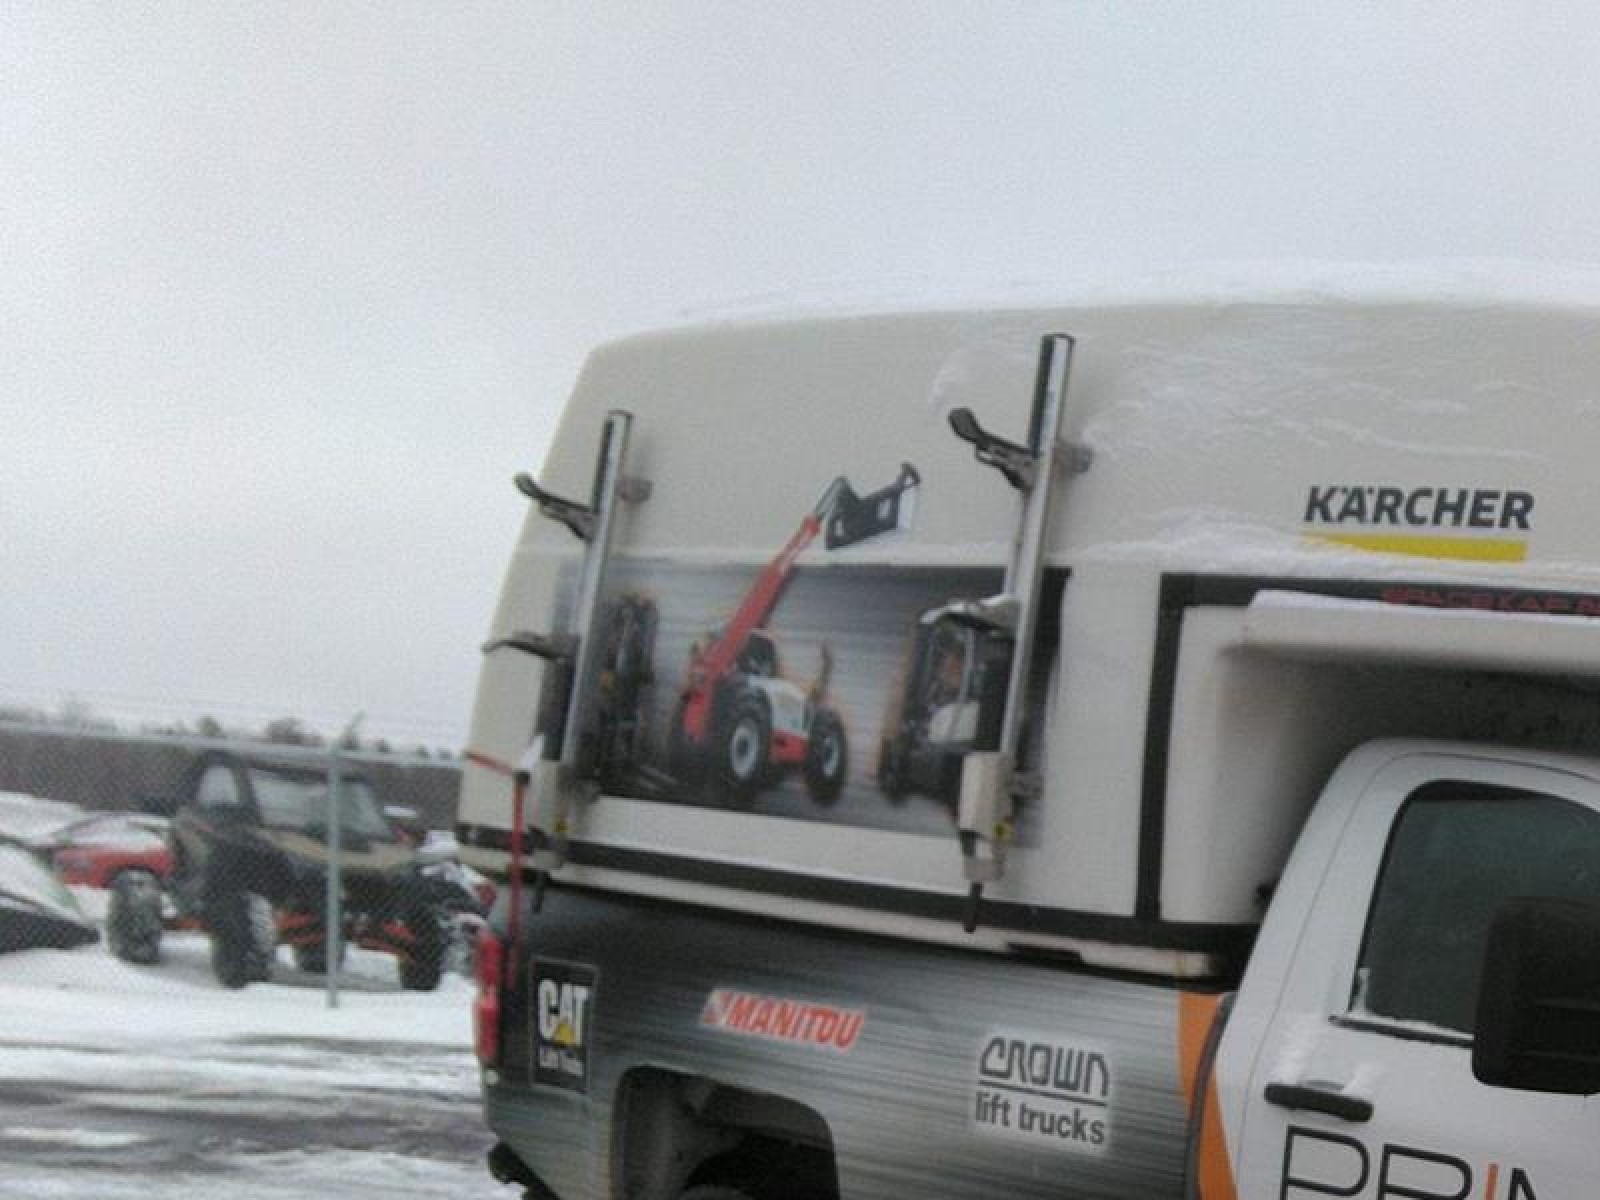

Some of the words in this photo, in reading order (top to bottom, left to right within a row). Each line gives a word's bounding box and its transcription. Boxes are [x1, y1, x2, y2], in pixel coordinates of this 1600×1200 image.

[1304, 484, 1536, 529] KÄRCHER
[537, 977, 590, 1047] CAT
[728, 990, 865, 1049] MANITOU
[976, 1090, 1011, 1127] lift
[1018, 1102, 1106, 1145] trucks
